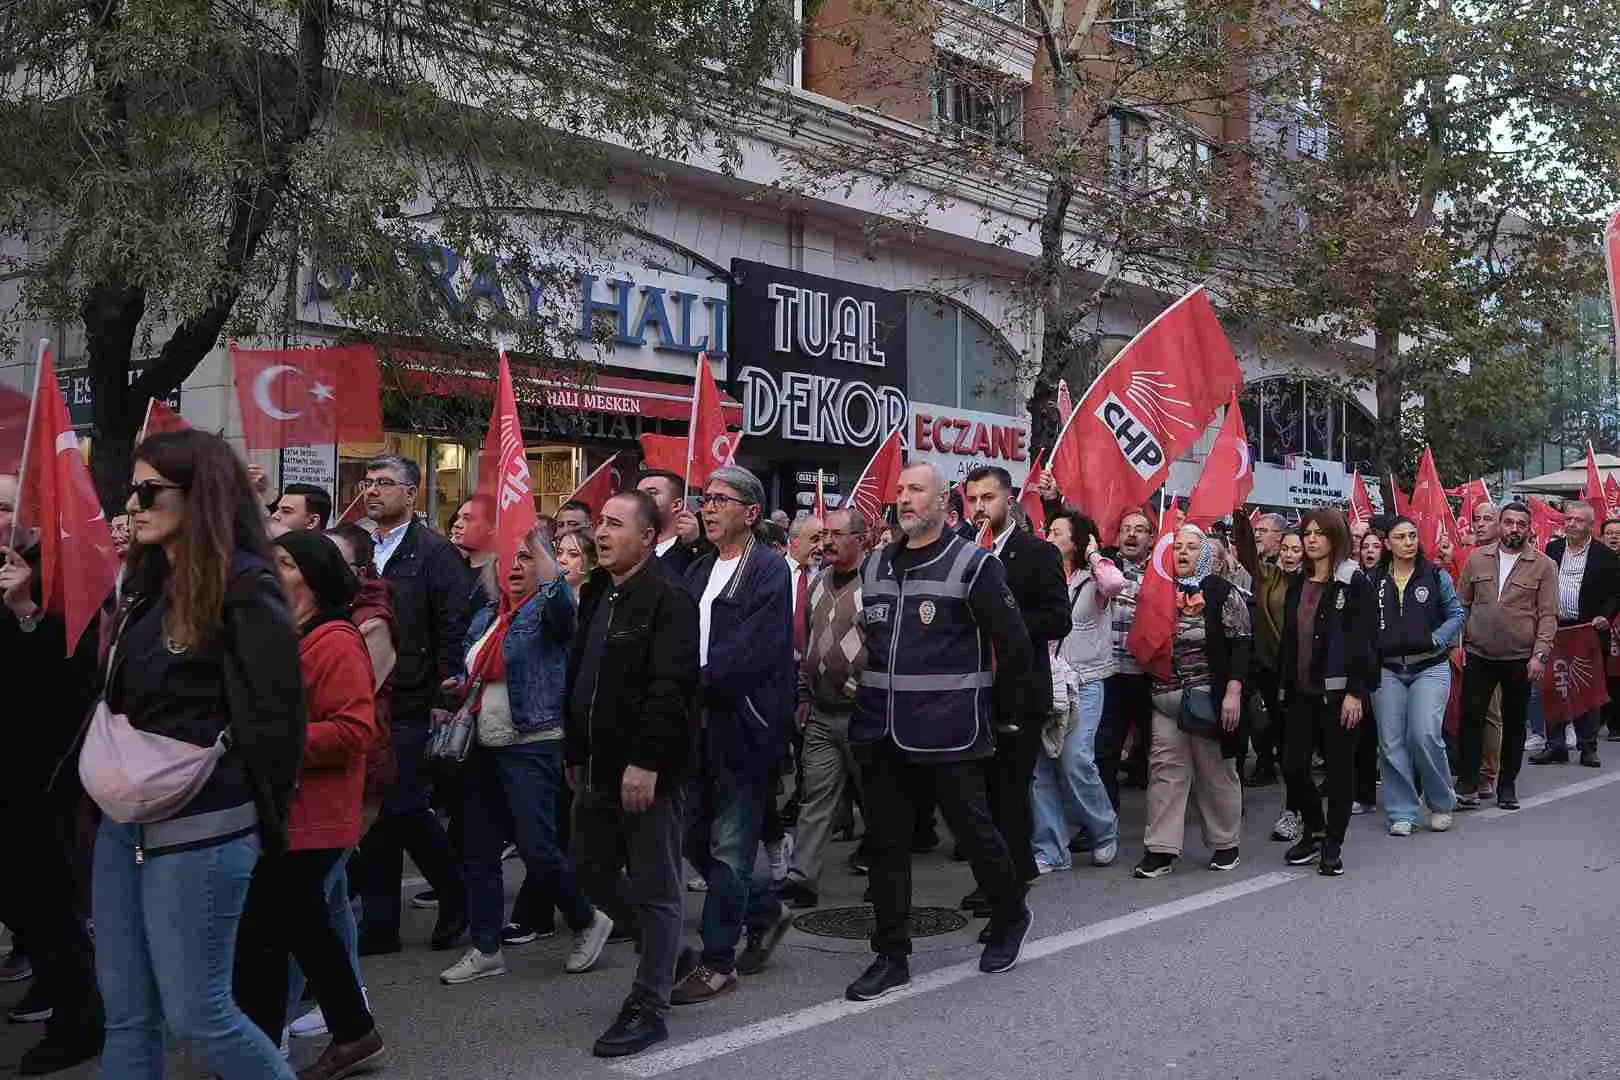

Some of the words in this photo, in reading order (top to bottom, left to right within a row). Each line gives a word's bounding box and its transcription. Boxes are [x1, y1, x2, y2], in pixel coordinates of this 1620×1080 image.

[576, 272, 729, 358] HALI
[767, 282, 887, 367] TUAL
[546, 390, 579, 408] HALI
[583, 394, 641, 413] MESKEN
[737, 365, 908, 450] DEKOR
[915, 413, 1027, 462] ECZANE
[1103, 402, 1162, 466] CHP
